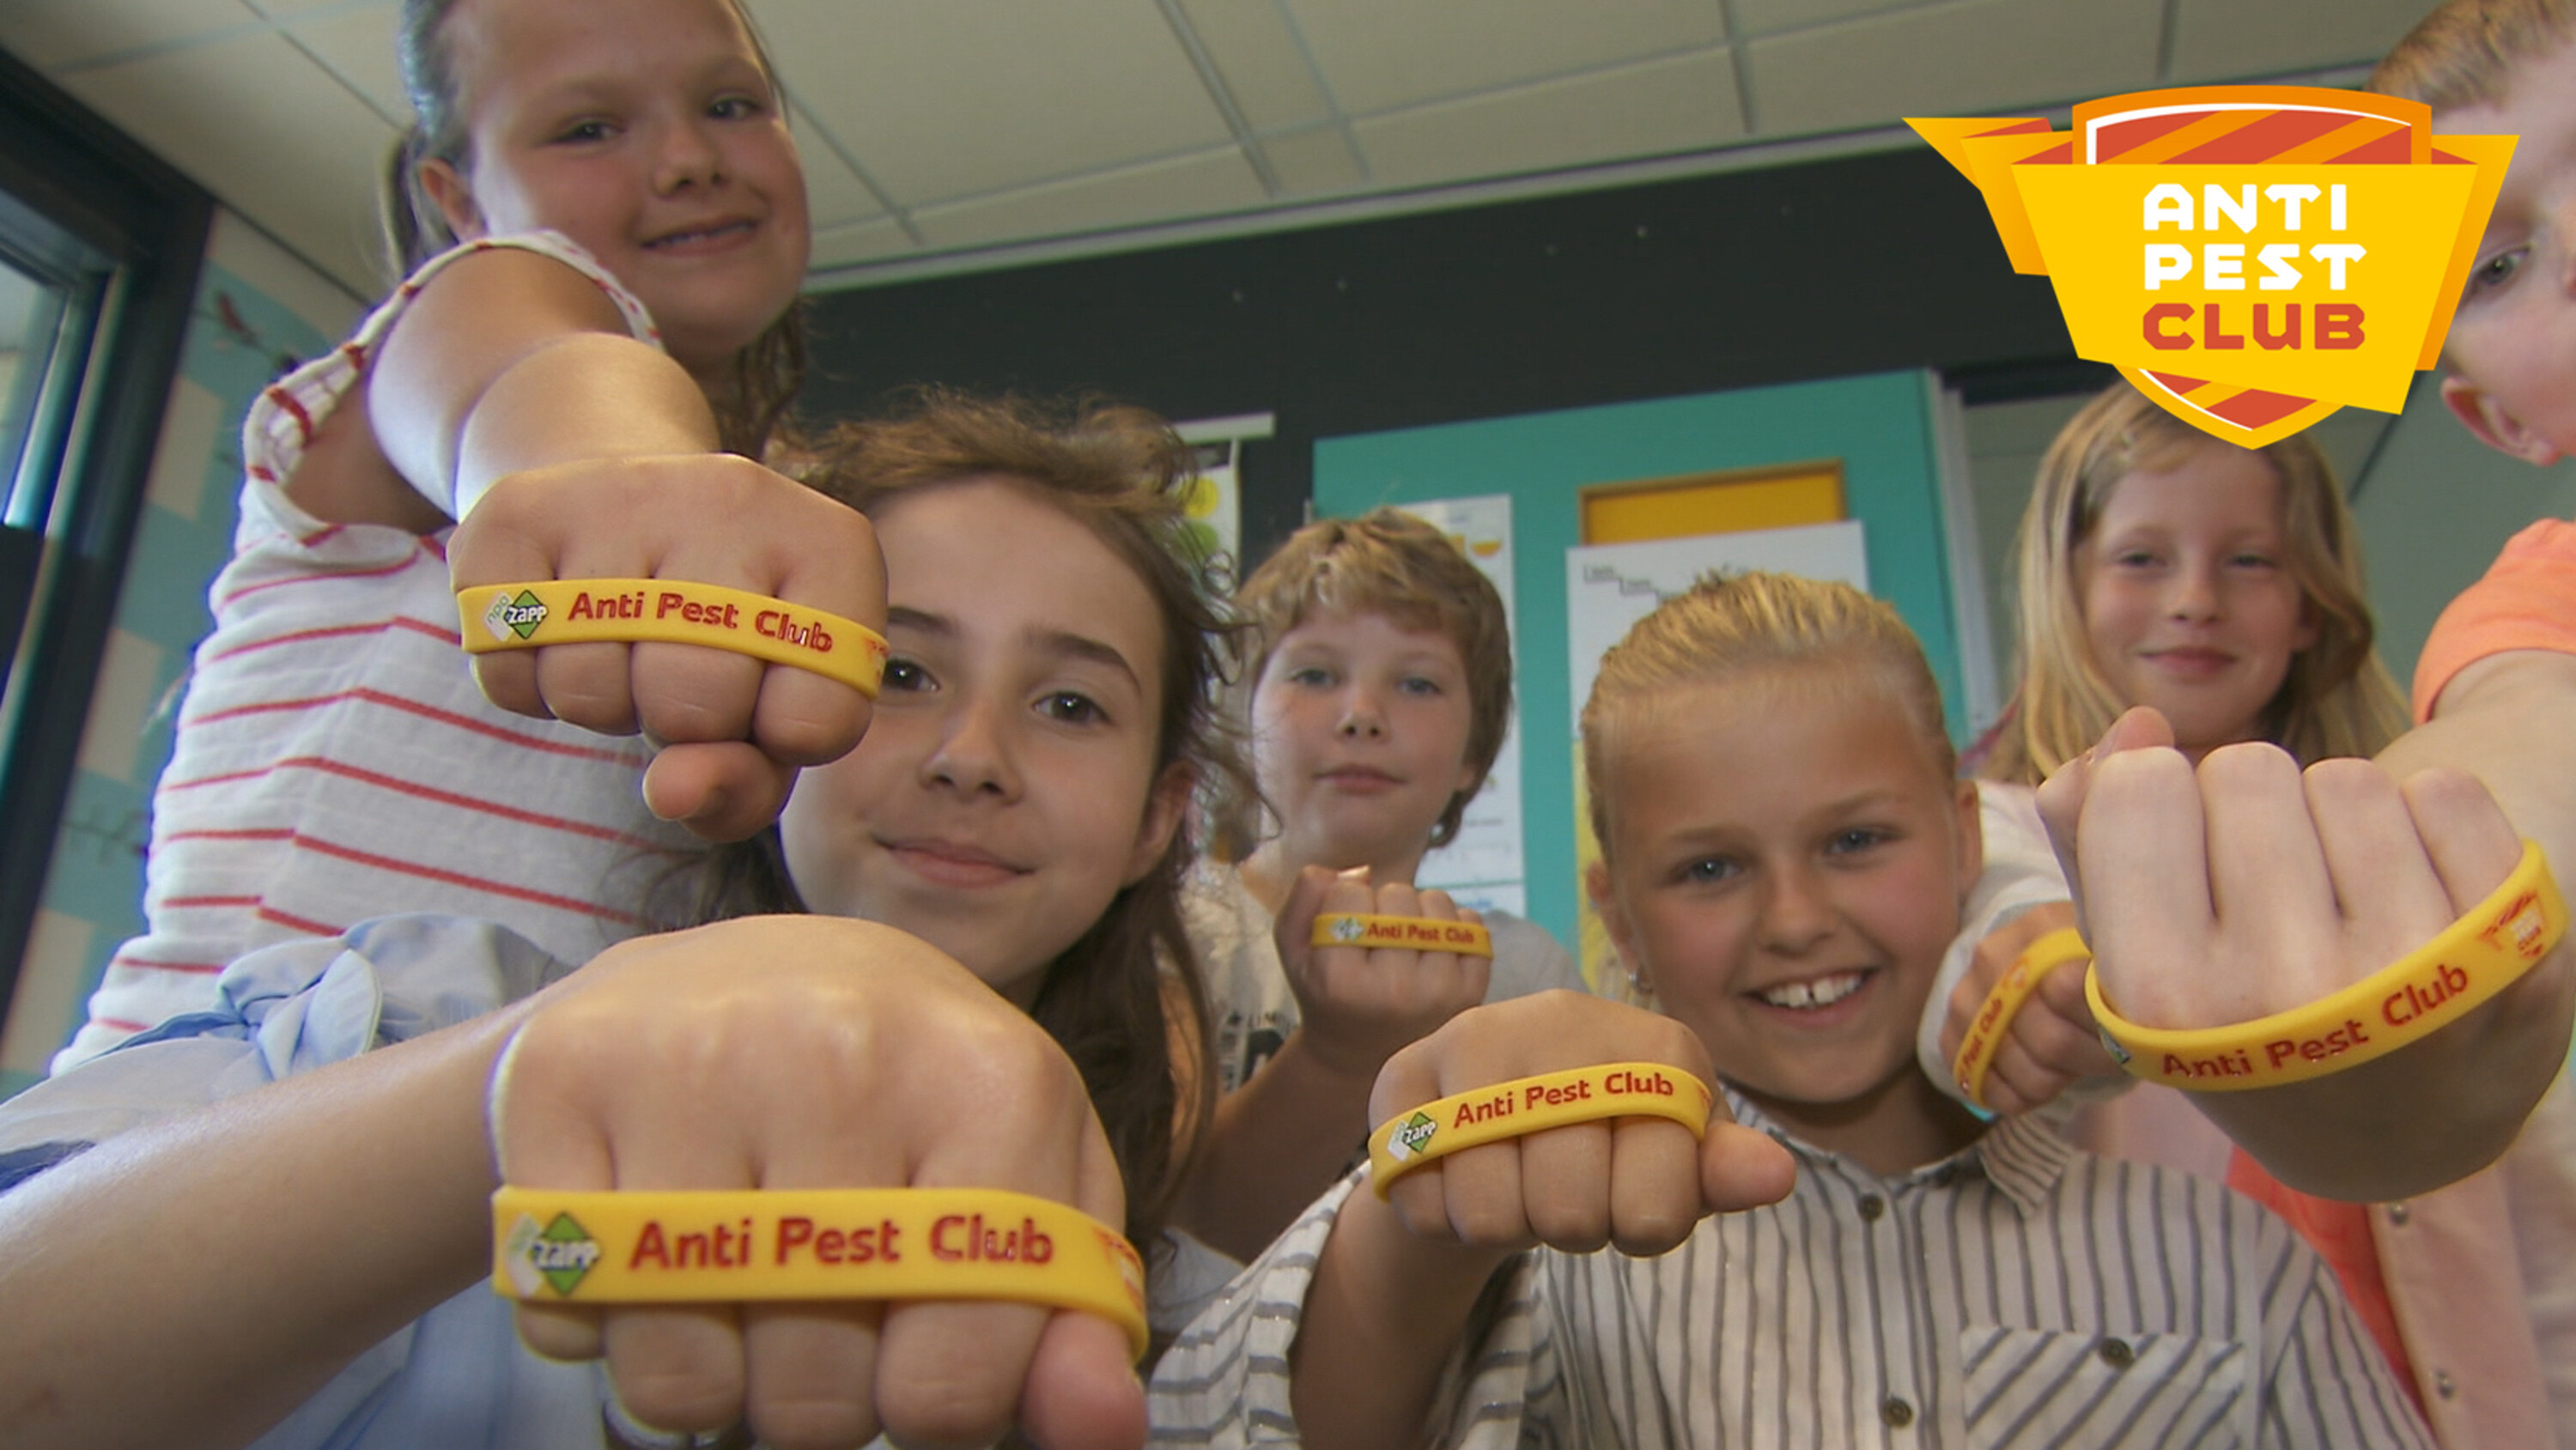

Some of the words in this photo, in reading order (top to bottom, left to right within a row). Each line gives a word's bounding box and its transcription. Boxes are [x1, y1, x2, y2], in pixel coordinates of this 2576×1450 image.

[568, 591, 646, 622] Anti
[656, 592, 738, 629] Pest
[755, 610, 834, 653] Club
[1367, 923, 1402, 939] Anti
[2162, 1049, 2253, 1078] Anti
[2263, 1018, 2370, 1071] Pest
[2381, 963, 2469, 1028] Club
[1453, 1090, 1514, 1129] Anti
[1525, 1078, 1591, 1111] Pest
[1604, 1071, 1674, 1096] Club
[629, 1218, 752, 1270] Anti
[775, 1216, 900, 1267] Pest
[929, 1213, 1054, 1265] Club
